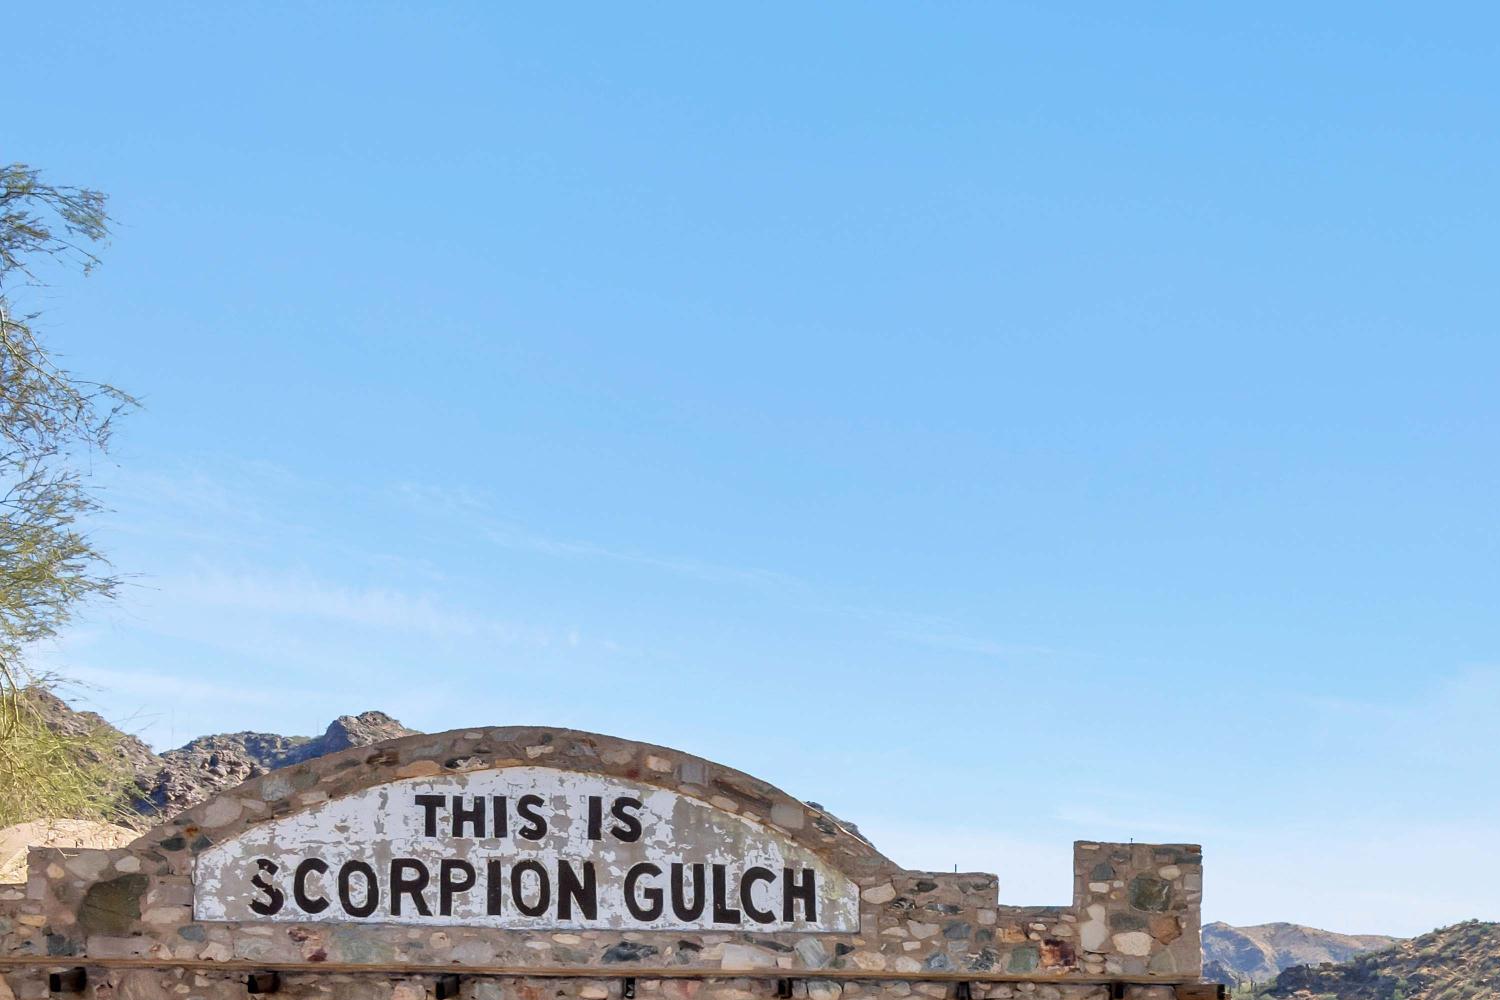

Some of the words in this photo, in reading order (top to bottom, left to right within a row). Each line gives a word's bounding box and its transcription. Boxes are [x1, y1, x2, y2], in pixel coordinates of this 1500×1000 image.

[415, 794, 550, 842] THIS
[588, 795, 642, 844] IS
[251, 857, 598, 921] SCORPION
[625, 863, 818, 923] GULCH
